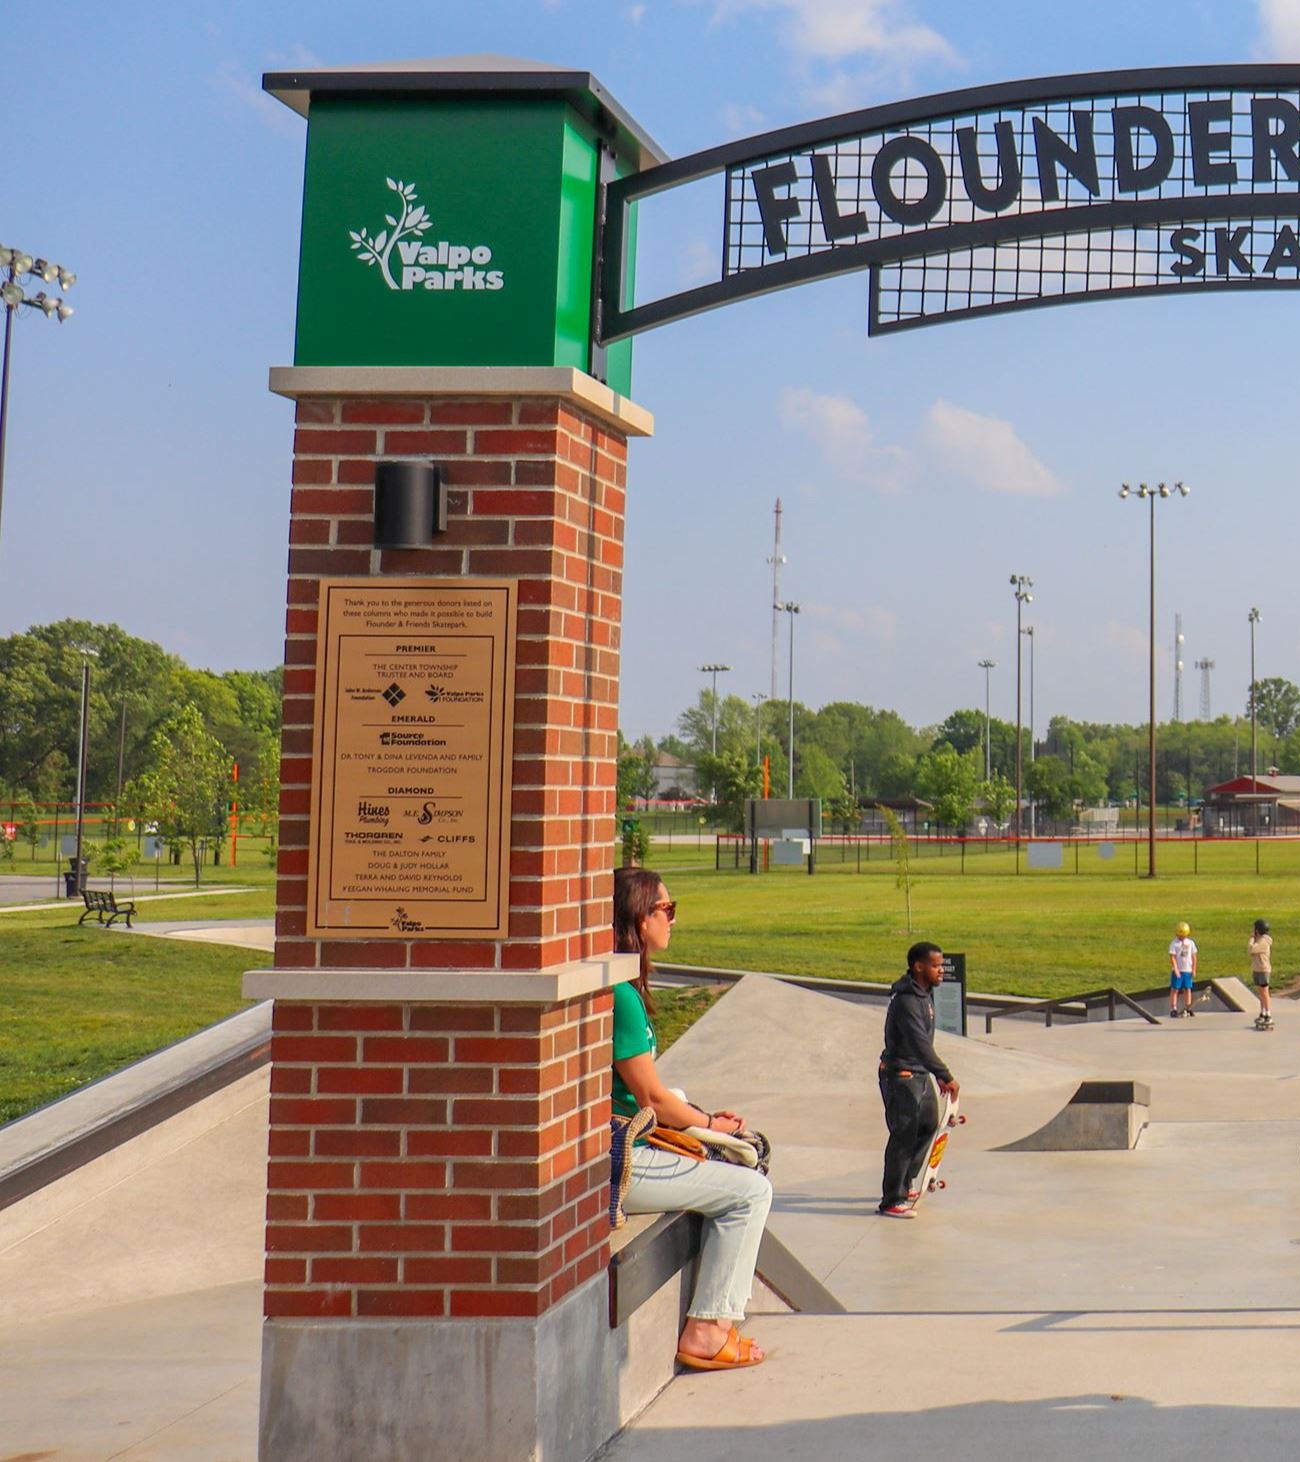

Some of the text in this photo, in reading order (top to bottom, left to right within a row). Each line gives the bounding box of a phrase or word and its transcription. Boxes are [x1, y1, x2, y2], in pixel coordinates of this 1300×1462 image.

[397, 241, 492, 269] Valpo
[402, 266, 504, 290] Parks
[437, 599, 461, 607] donors
[463, 599, 482, 607] listed
[343, 609, 362, 617] these
[437, 610, 465, 619] possible
[366, 620, 396, 628] Flounder
[395, 645, 436, 653] PREMIER
[358, 801, 390, 817] Hines
[437, 835, 475, 843] CLIFFS
